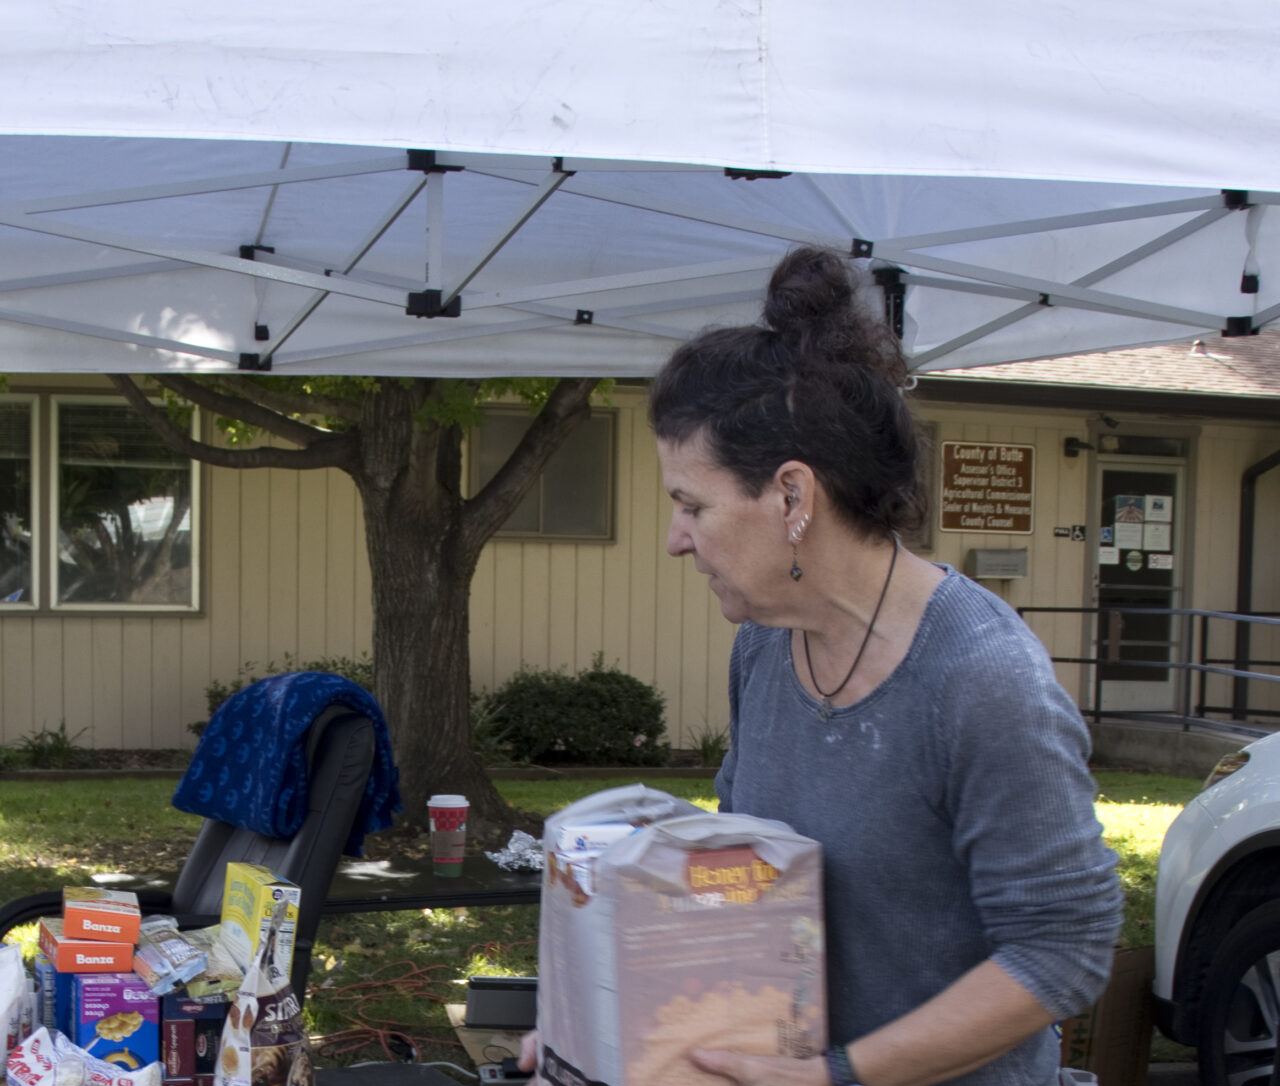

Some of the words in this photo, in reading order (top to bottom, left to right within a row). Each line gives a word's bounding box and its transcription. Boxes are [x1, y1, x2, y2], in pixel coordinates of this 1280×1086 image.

[953, 445, 985, 463] County
[987, 447, 998, 461] of
[1000, 447, 1024, 462] Butte
[960, 463, 995, 475] Assessor's
[996, 464, 1017, 476] Office
[991, 475, 1017, 488] District
[943, 487, 985, 501] Agricultural
[960, 515, 985, 528] County
[986, 516, 1014, 528] Counsel
[82, 918, 121, 934] Banza
[75, 953, 115, 965] Banza
